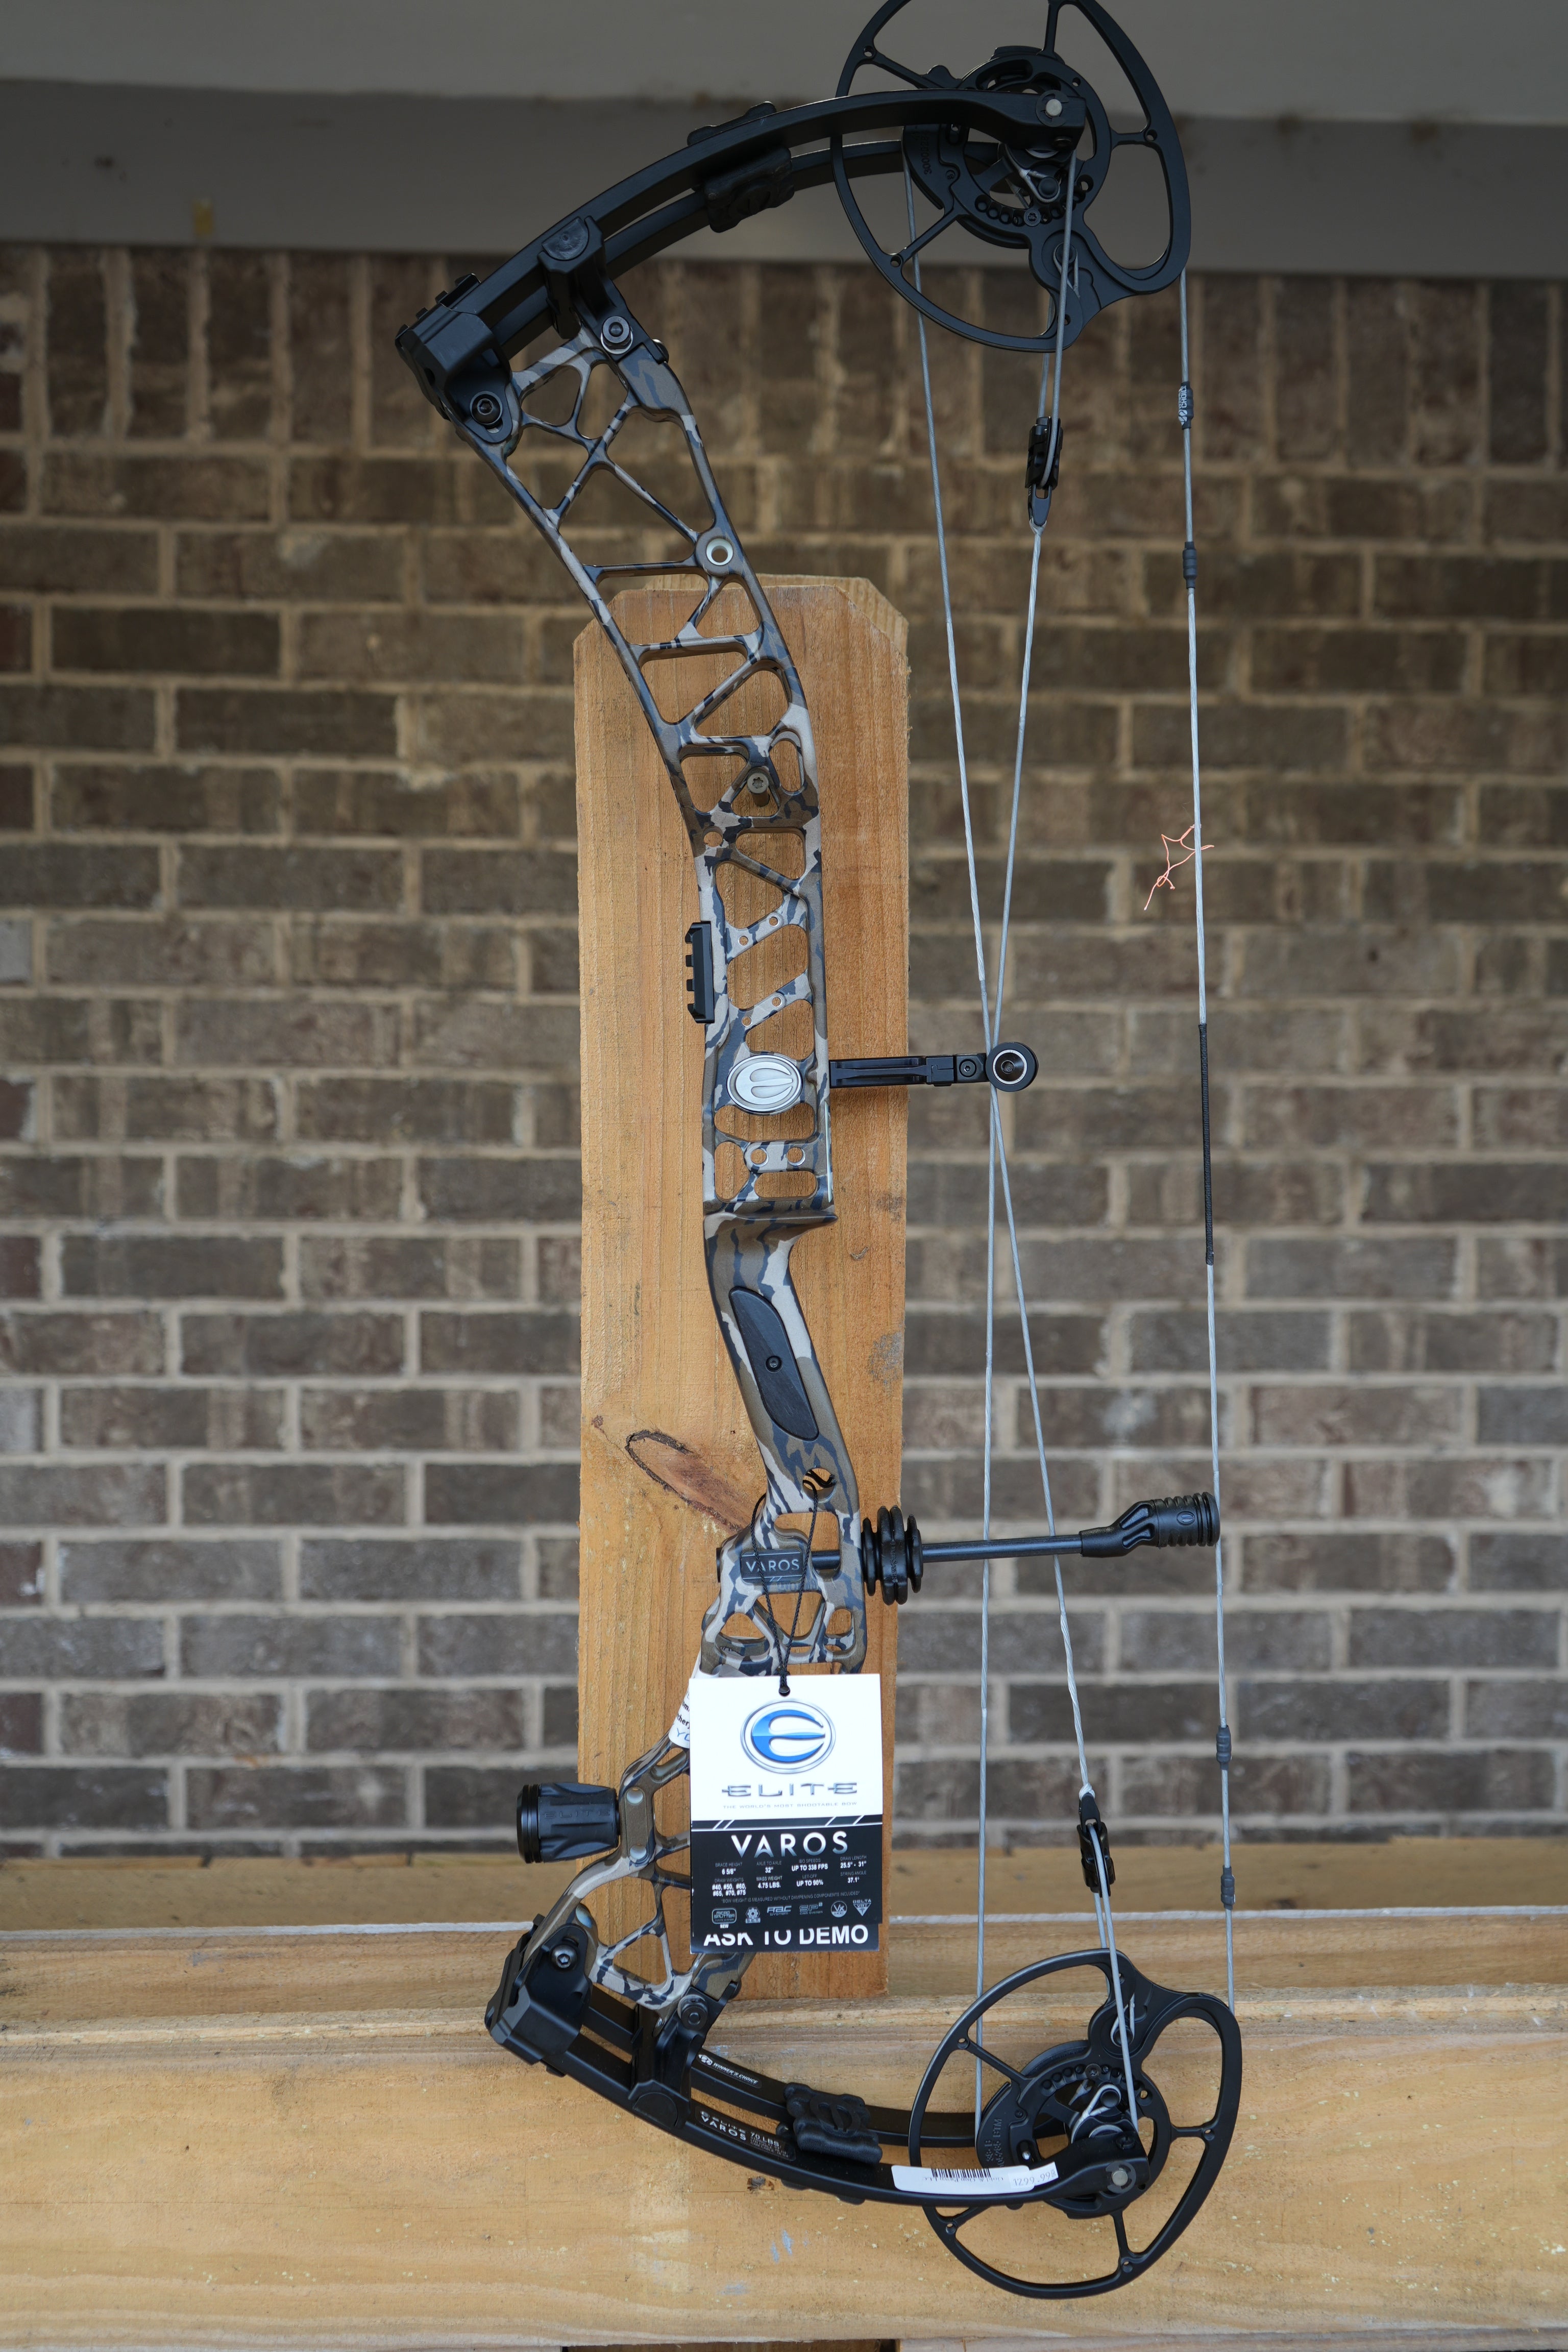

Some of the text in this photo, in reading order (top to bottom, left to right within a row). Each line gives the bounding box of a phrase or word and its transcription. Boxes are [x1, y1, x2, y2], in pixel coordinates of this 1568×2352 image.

[746, 1559, 800, 1573] VAROS
[722, 1782, 857, 1797] ELITE
[731, 1830, 848, 1858] VAROS
[703, 1932, 753, 1946] ASK
[799, 1924, 868, 1945] DEMO
[739, 2074, 758, 2084] CHOICE
[701, 2115, 746, 2141] VAROS
[751, 2132, 760, 2140] 70
